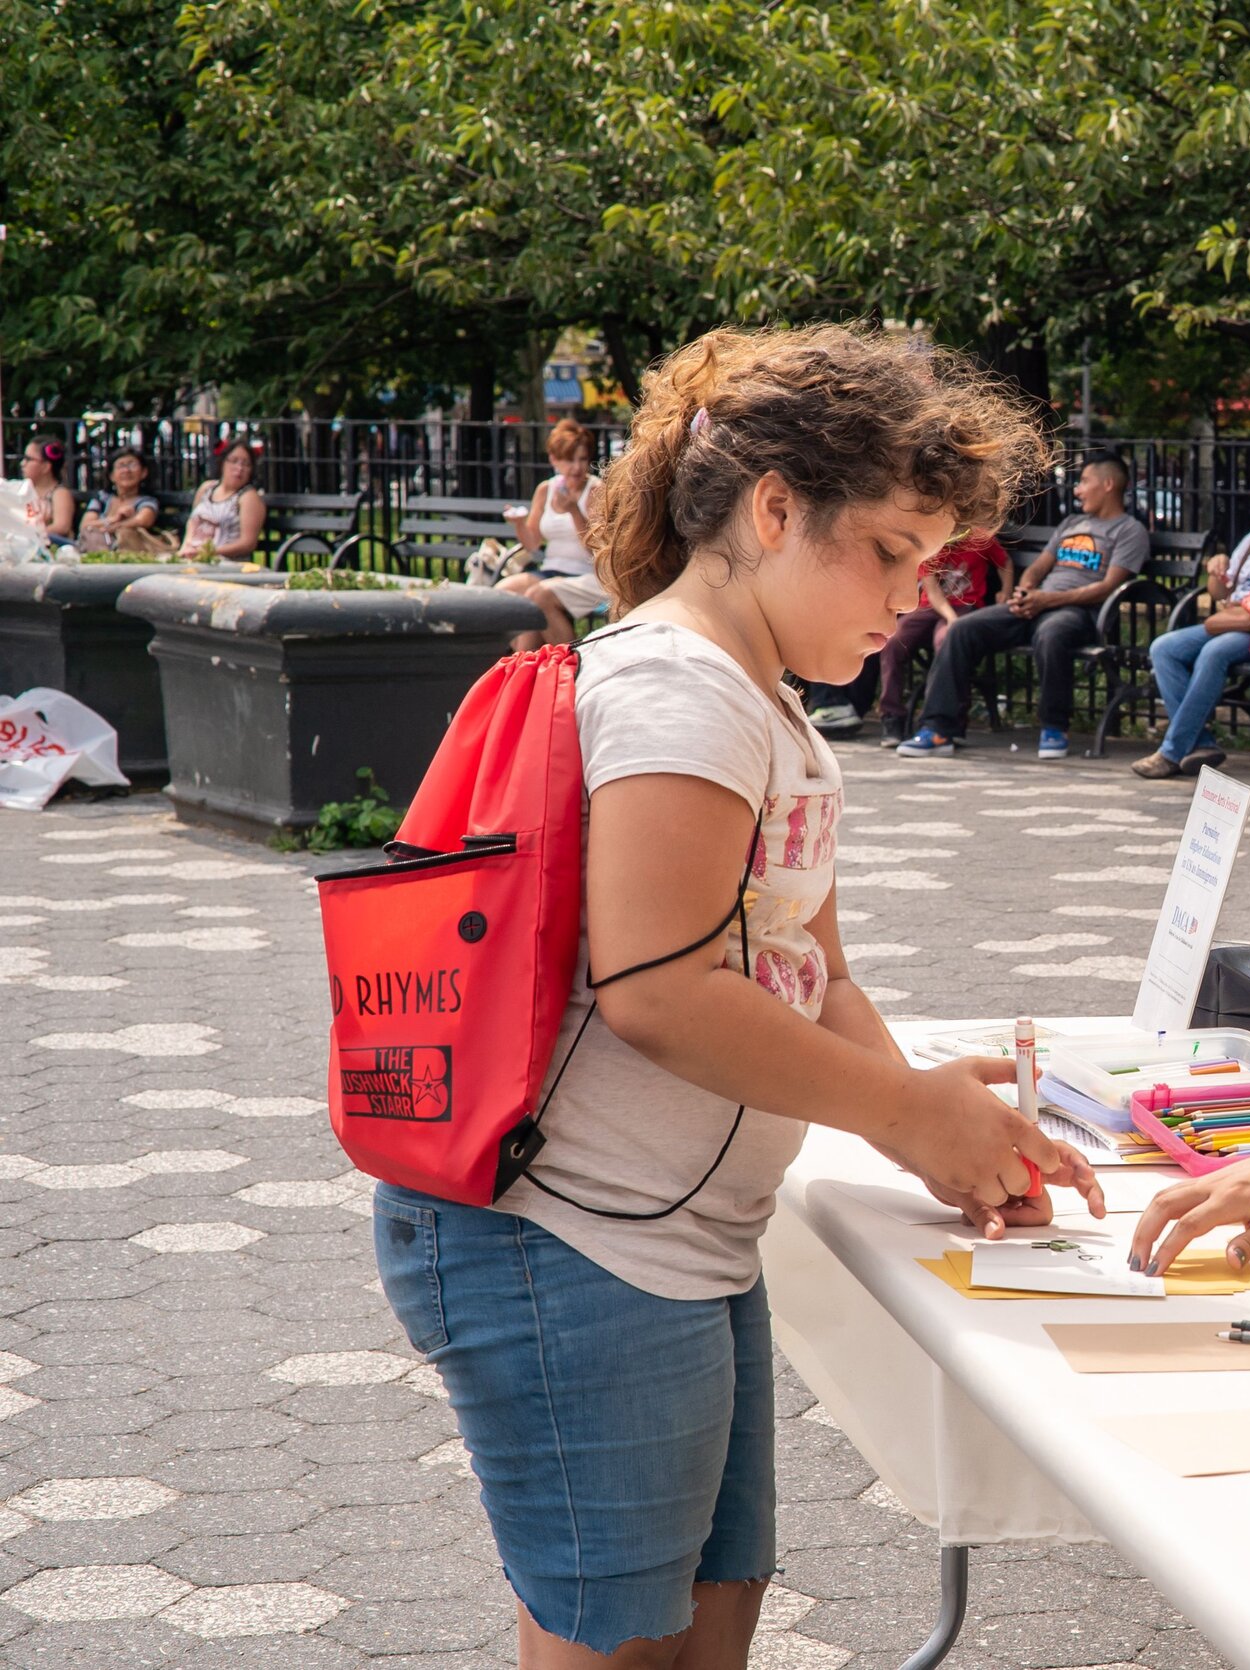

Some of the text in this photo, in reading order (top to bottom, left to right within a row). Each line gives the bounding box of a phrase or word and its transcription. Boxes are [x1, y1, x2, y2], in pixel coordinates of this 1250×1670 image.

[1201, 786, 1218, 801] Summer
[1225, 797, 1241, 814] Festival
[1189, 838, 1221, 865] Higher Education
[1172, 906, 1189, 932] DACA
[356, 968, 461, 1016] RHYMES
[379, 1048, 412, 1071] THE
[342, 1072, 412, 1094] USHWICK
[370, 1094, 413, 1118] STARR
